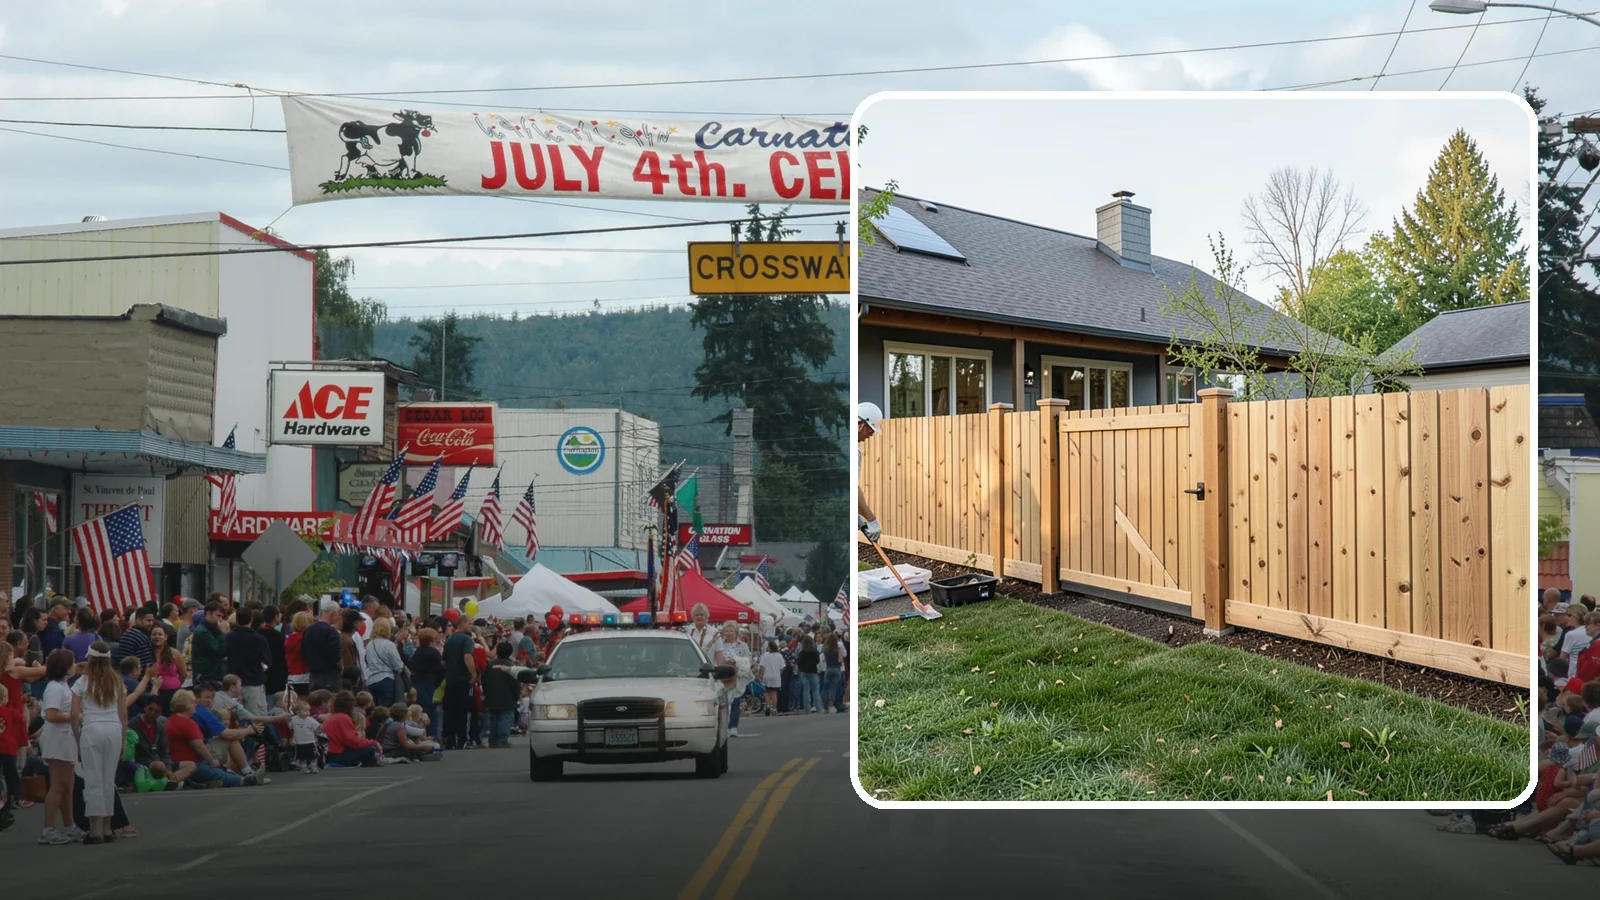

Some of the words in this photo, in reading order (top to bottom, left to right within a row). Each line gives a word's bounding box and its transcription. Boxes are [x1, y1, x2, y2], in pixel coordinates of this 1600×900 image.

[481, 141, 604, 192] JULY
[632, 151, 747, 197] 4th.
[696, 254, 850, 280] CROSSWA
[282, 380, 373, 420] ACE
[406, 409, 452, 422] CEDAR
[461, 409, 485, 422] LOG
[283, 421, 371, 436] Hardware
[416, 428, 477, 447] Coca-Cola
[96, 486, 124, 495] Vincent
[126, 486, 136, 495] de
[138, 486, 155, 495] Paul
[688, 526, 741, 535] CRNATION
[699, 535, 730, 544] GLASS
